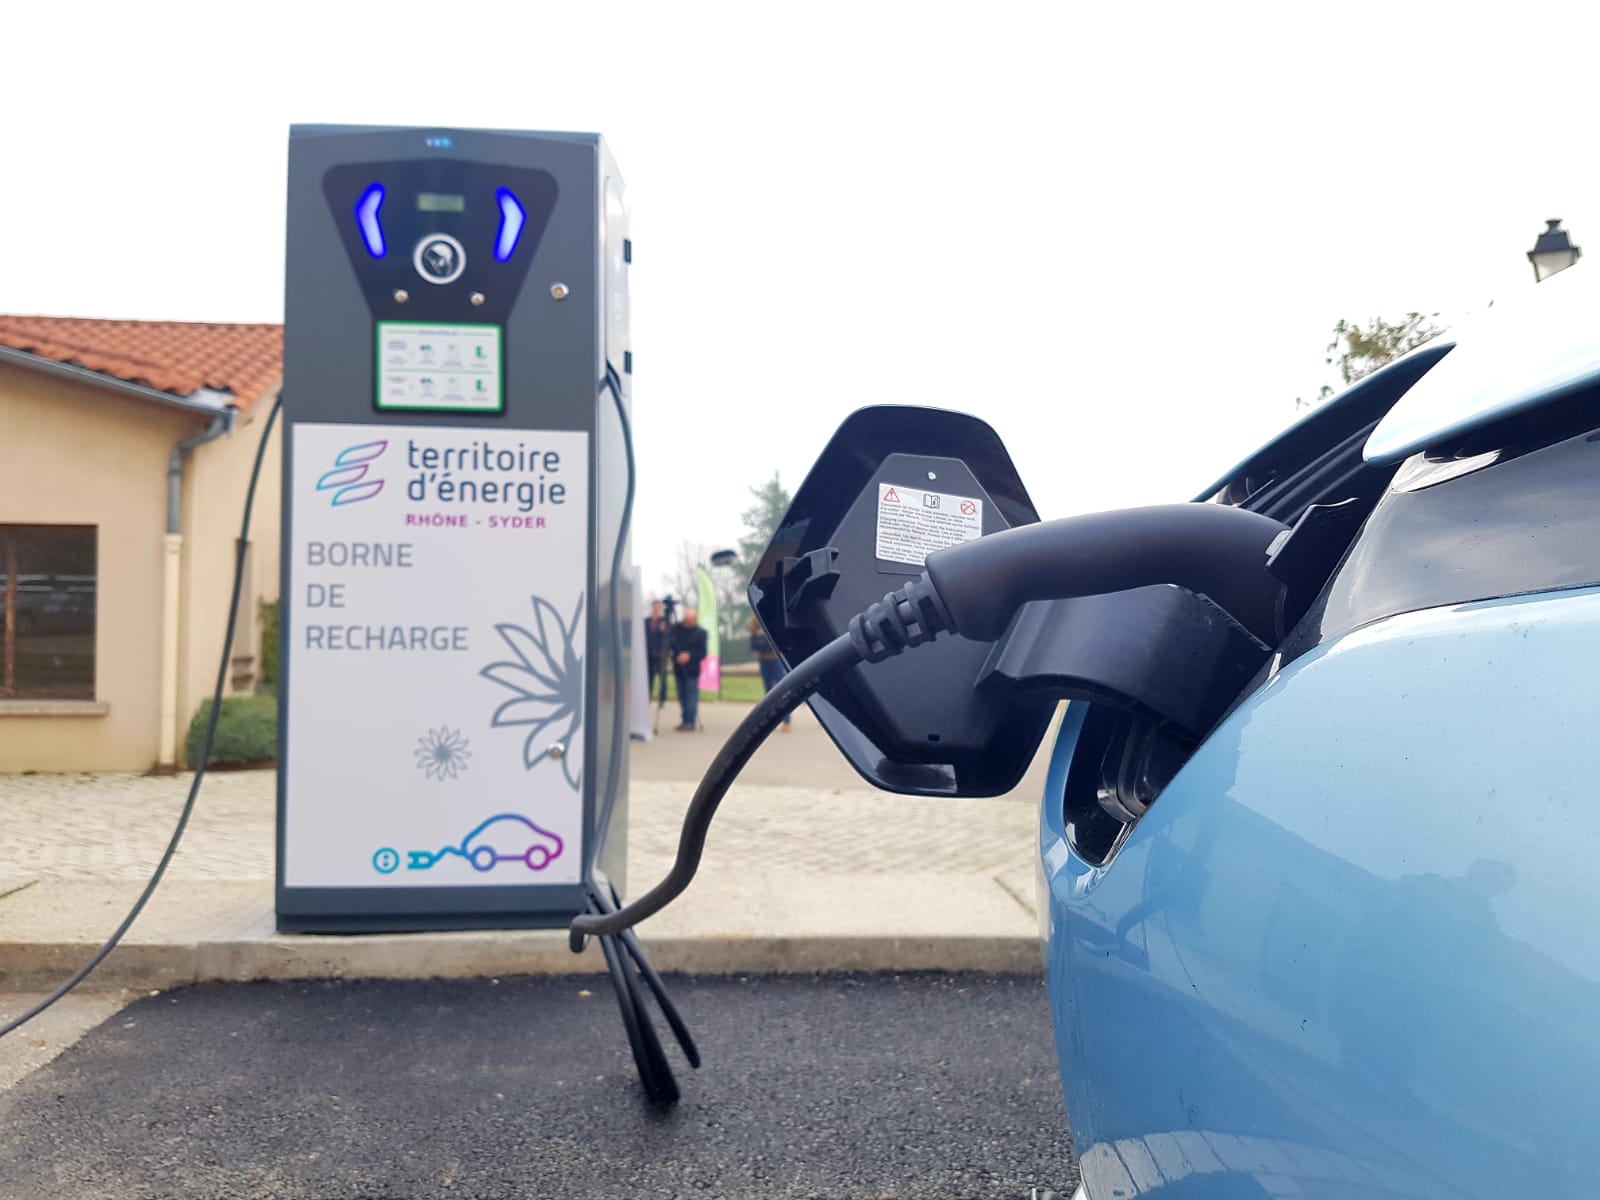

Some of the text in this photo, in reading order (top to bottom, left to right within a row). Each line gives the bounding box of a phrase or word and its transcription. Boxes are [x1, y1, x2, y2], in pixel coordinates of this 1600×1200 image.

[407, 439, 561, 473] territoire
[406, 513, 468, 528] RHÔNE
[488, 515, 546, 529] SYDER
[307, 542, 413, 568] BORNE
[306, 583, 346, 609] DE
[305, 625, 468, 651] RECHARGE
